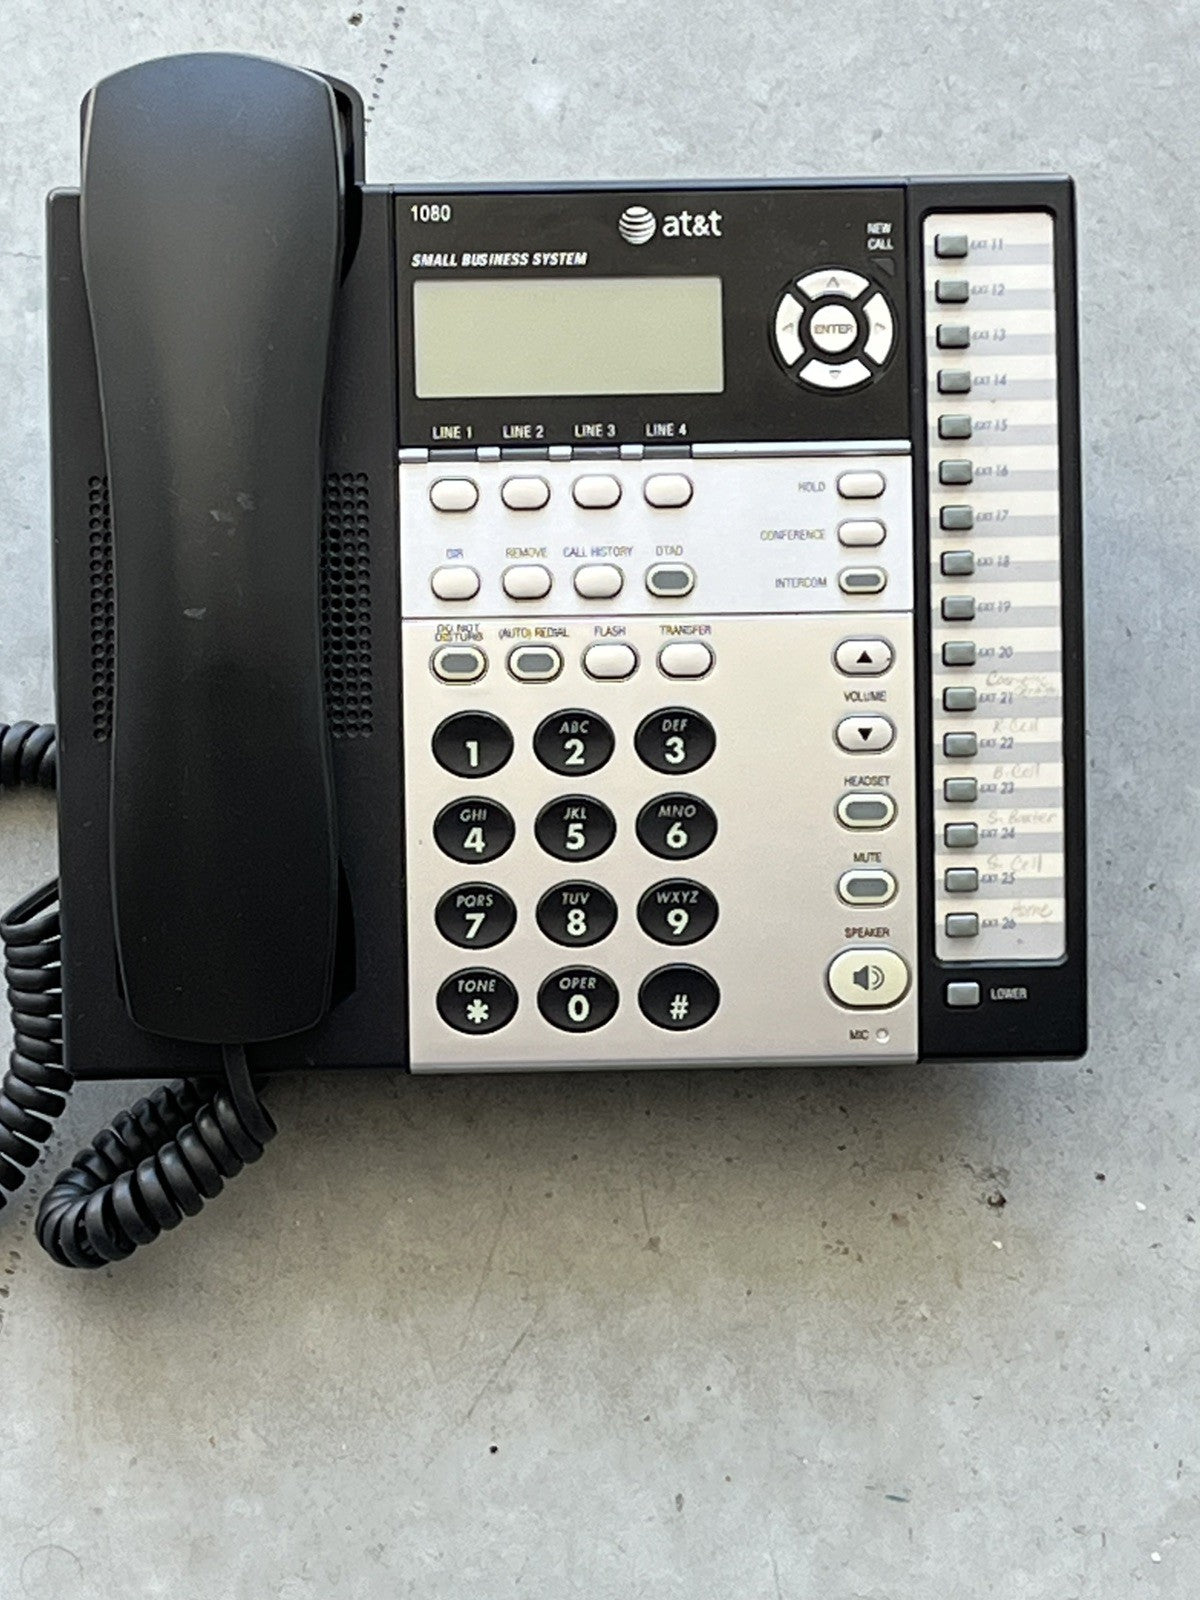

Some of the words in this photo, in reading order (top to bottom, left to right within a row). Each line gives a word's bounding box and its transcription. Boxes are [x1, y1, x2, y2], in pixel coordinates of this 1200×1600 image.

[410, 204, 451, 222] 1080
[661, 209, 723, 237] at&t
[867, 222, 892, 234] NEW
[867, 238, 893, 250] CALL
[991, 238, 1004, 250] 11
[411, 254, 458, 267] SMALL
[461, 253, 529, 266] BUSINESS
[532, 252, 588, 265] SYSTEM
[992, 283, 1005, 295] 12
[813, 323, 854, 335] ENTER
[993, 329, 1006, 341] 13
[994, 374, 1007, 386] 14
[502, 425, 532, 438] LINE
[535, 425, 544, 438] 2
[574, 424, 603, 437] LINE
[606, 424, 616, 437] 3
[645, 423, 675, 436] LINE
[678, 423, 687, 436] 4
[994, 419, 1008, 431] 15
[432, 426, 461, 440] LINE
[466, 426, 473, 440] 1
[995, 464, 1009, 477] 16
[798, 481, 826, 492] HOLD
[996, 510, 1009, 522] 17
[760, 529, 825, 541] CONFERENCE
[505, 547, 548, 558] REMOVE
[562, 546, 588, 557] CALL
[591, 546, 634, 557] HISTORY
[997, 555, 1011, 567] 18
[775, 577, 828, 588] INTERCOM
[998, 600, 1011, 612] 19
[594, 626, 627, 637] FLASH
[659, 625, 711, 636] TRANSFER
[999, 646, 1014, 658] 20
[843, 690, 887, 702] VOLUME
[1000, 691, 1013, 704] 21
[559, 720, 590, 734] ABC
[661, 718, 688, 732] DEF
[1000, 737, 1014, 749] 22
[465, 740, 479, 767] 1
[564, 738, 585, 765] 2
[664, 736, 686, 764] 3
[844, 775, 891, 787] HEADSET
[1000, 782, 1015, 794] 23
[459, 808, 487, 822] GHI
[563, 806, 587, 820] JKL
[657, 804, 697, 818] MNO
[565, 823, 586, 850] 5
[665, 821, 688, 848] 6
[1001, 827, 1015, 839] 24
[463, 827, 486, 853] 4
[853, 852, 882, 863] MUTE
[1001, 872, 1016, 885] 25
[455, 894, 494, 908] PQRS
[562, 891, 590, 905] TUV
[656, 890, 699, 904] WXYZ
[465, 912, 486, 939] 7
[566, 908, 587, 936] 8
[666, 908, 689, 935] 9
[844, 927, 890, 938] SPEAKER
[457, 978, 496, 993] TONE
[559, 977, 597, 990] OPER
[990, 987, 1028, 1000] LOWER
[567, 994, 590, 1022] 0
[669, 994, 689, 1020] #
[849, 1029, 869, 1040] MIC
